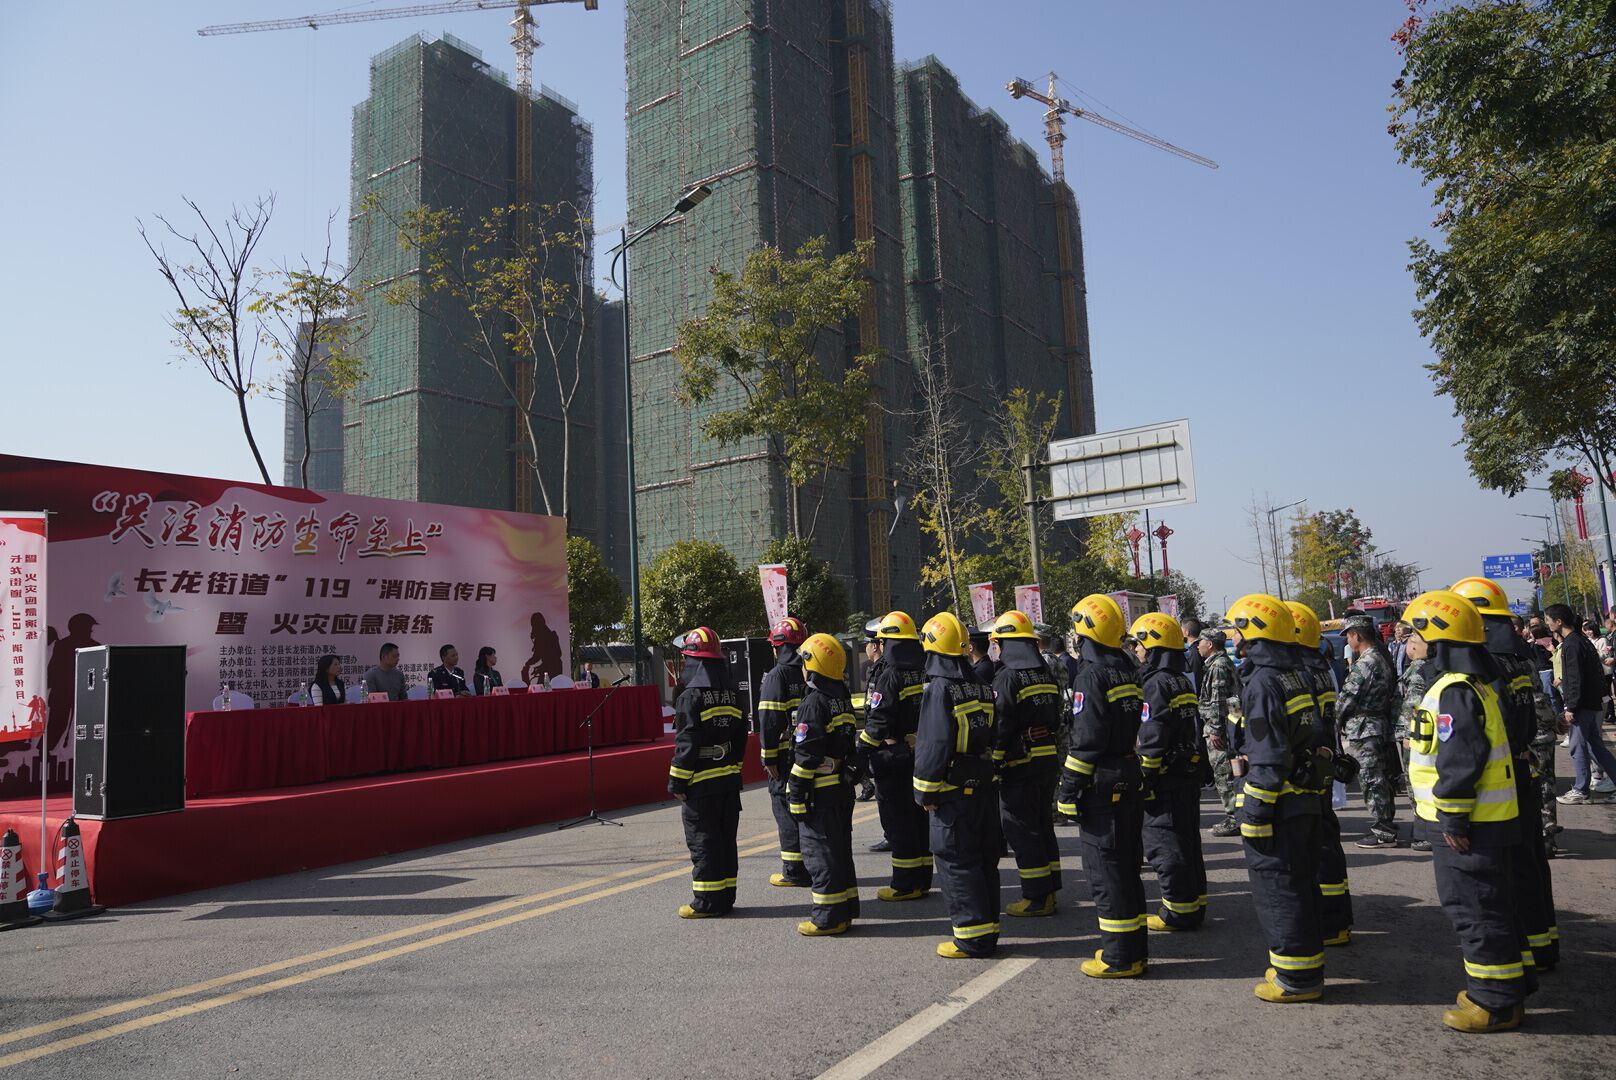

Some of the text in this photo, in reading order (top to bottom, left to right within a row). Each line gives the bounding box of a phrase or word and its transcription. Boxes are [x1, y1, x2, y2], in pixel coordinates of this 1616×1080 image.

[215, 612, 434, 636] 暨 火灾应急演练
[69, 850, 81, 888] 禁止停车
